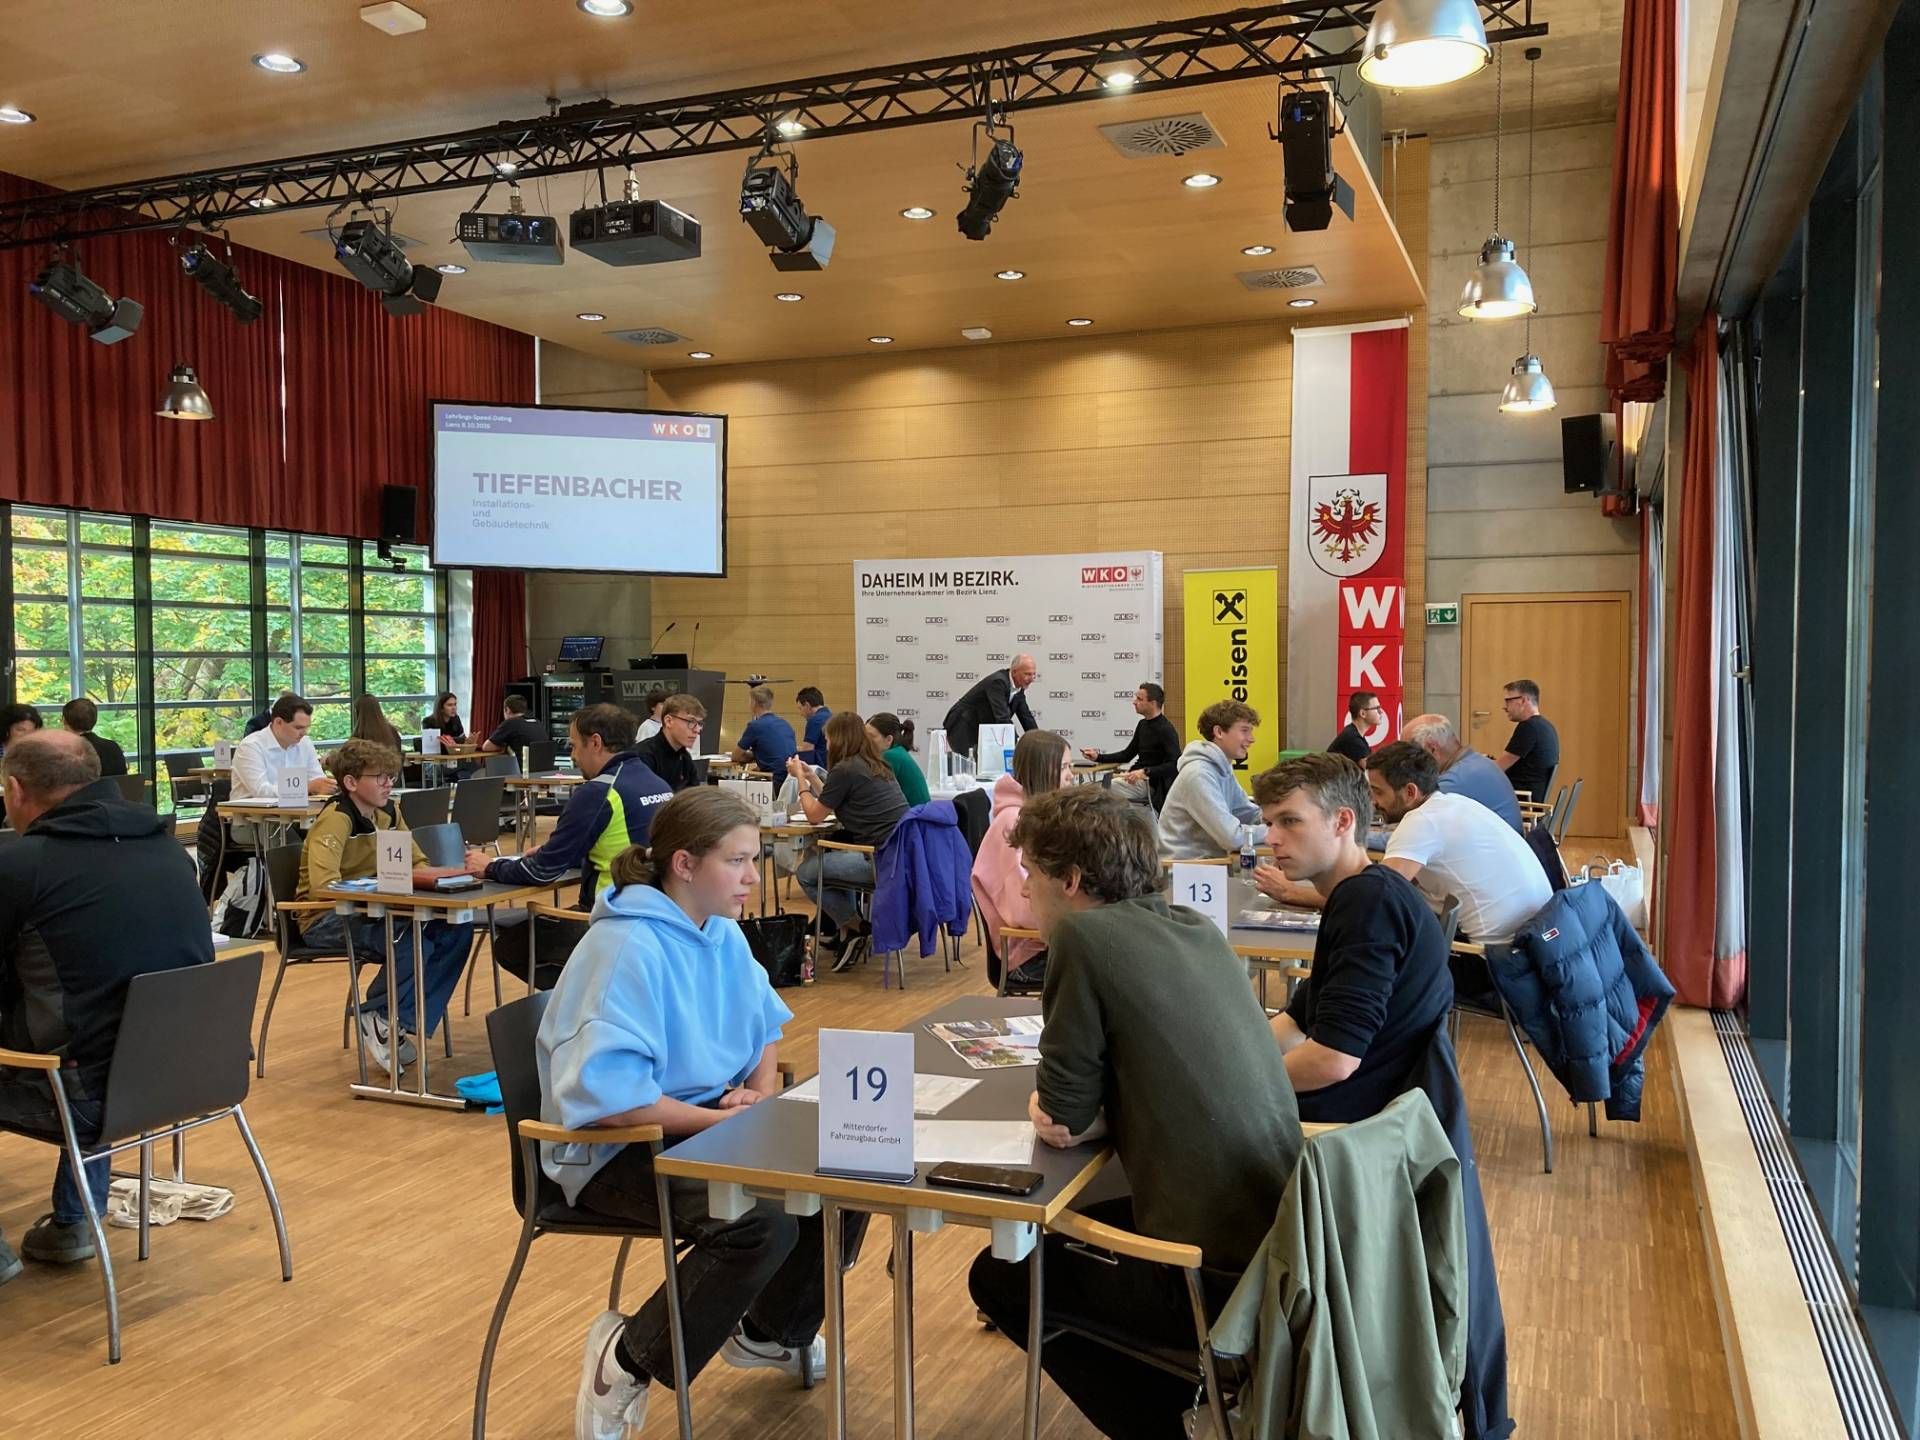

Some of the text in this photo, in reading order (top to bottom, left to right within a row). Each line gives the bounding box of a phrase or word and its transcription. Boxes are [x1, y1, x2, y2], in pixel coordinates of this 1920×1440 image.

[653, 423, 694, 436] WKO
[472, 472, 683, 501] TIEFENBACHER
[472, 499, 535, 509] Installations-
[472, 509, 491, 518] und
[861, 570, 1019, 588] DAHEIM IM BEZIRK.
[1083, 568, 1126, 582] WKO
[876, 589, 944, 597] Unternehmerkammer
[956, 588, 977, 596] Bezirk
[286, 776, 300, 788] 10
[751, 792, 769, 805] 11b
[386, 846, 403, 863] 14
[1188, 883, 1213, 903] 13
[845, 1065, 889, 1103] 19
[843, 1122, 888, 1133] Mitterdorfer
[830, 1131, 901, 1145] Fahrzeugbau GmbH
